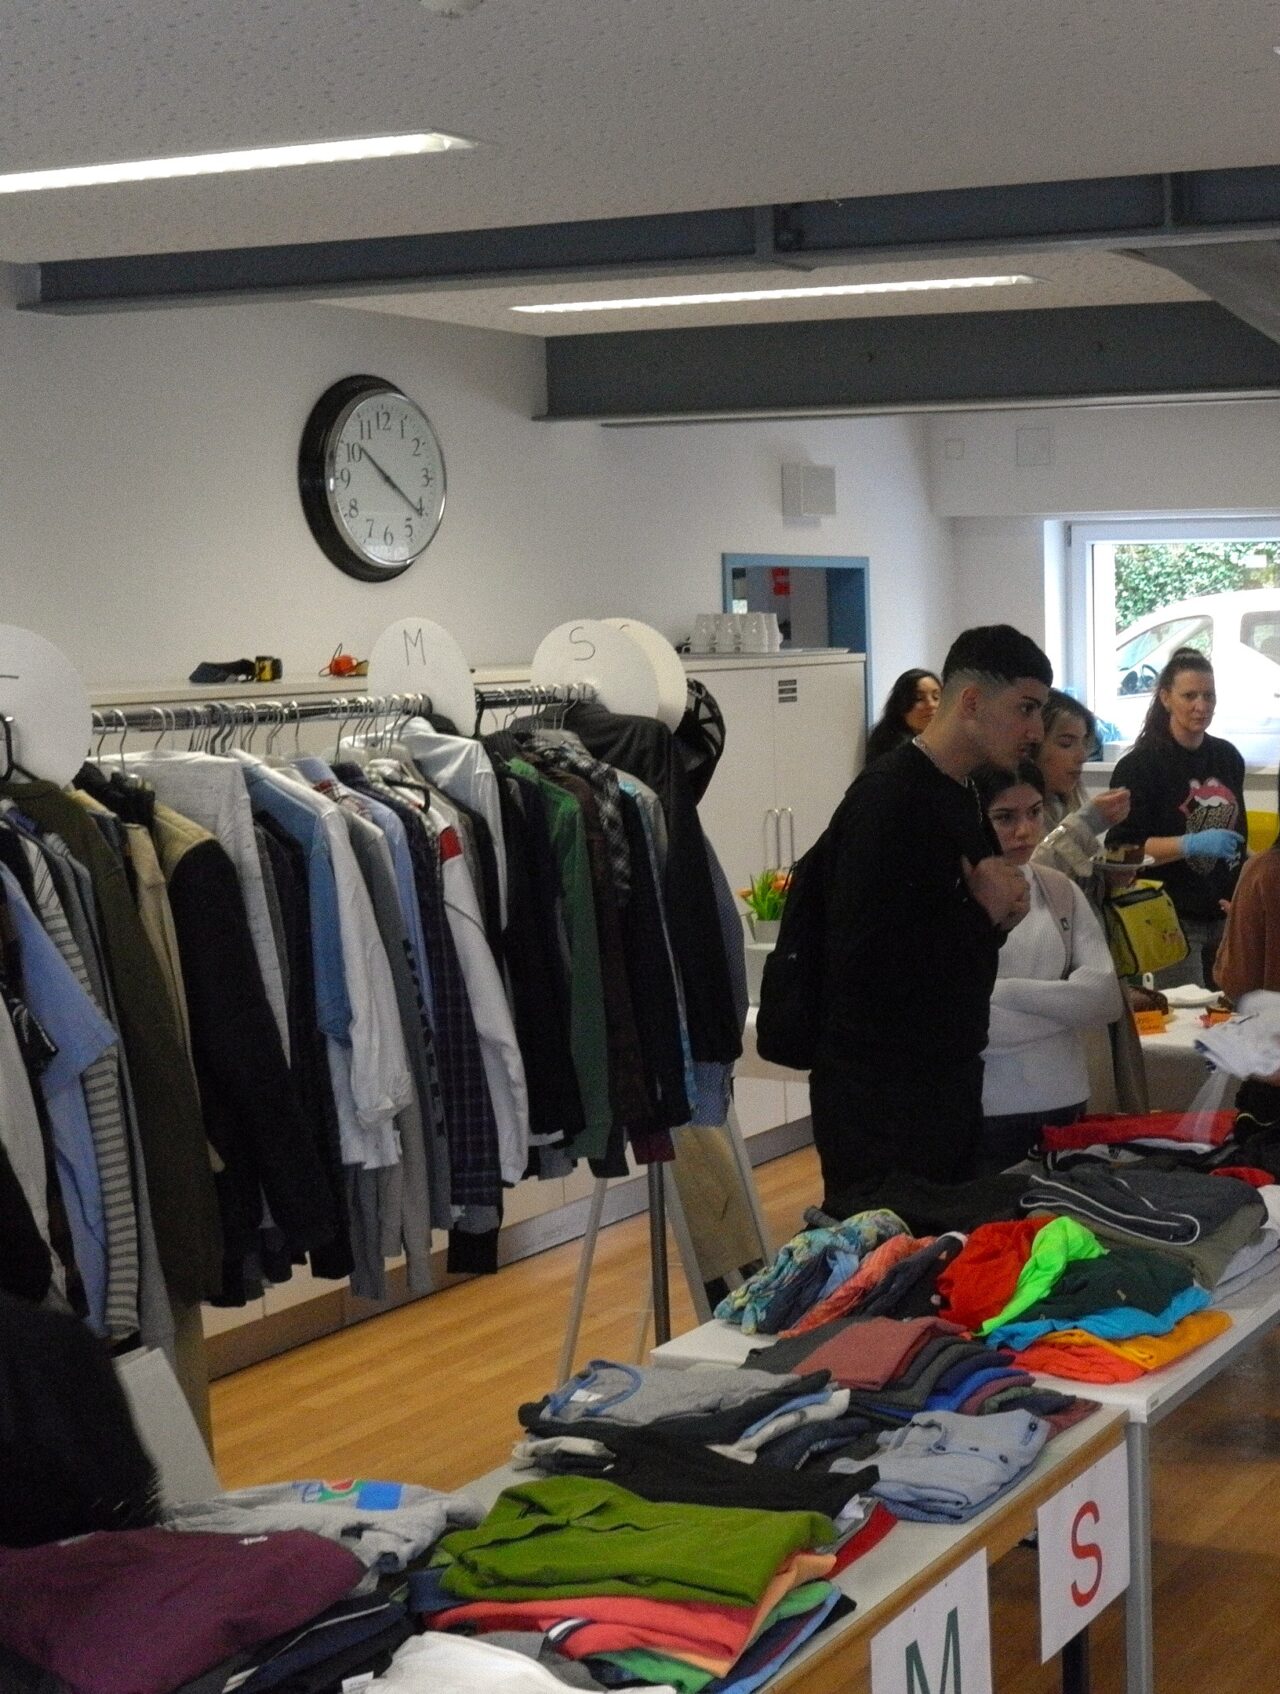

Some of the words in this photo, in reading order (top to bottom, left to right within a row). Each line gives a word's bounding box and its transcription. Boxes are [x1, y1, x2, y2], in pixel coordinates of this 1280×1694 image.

[360, 419, 372, 440] 11
[376, 411, 392, 431] 12
[400, 418, 405, 439] 1
[345, 442, 362, 462] 10
[411, 438, 421, 457] 2
[340, 467, 351, 489] 9
[422, 467, 432, 488] 3
[348, 499, 359, 518] 8
[413, 497, 425, 516] 4
[366, 518, 375, 538] 7
[383, 525, 394, 546] 6
[404, 517, 414, 538] 5
[402, 627, 427, 666] M
[569, 625, 596, 661] S
[1071, 1501, 1103, 1608] S
[905, 1606, 962, 1694] M
